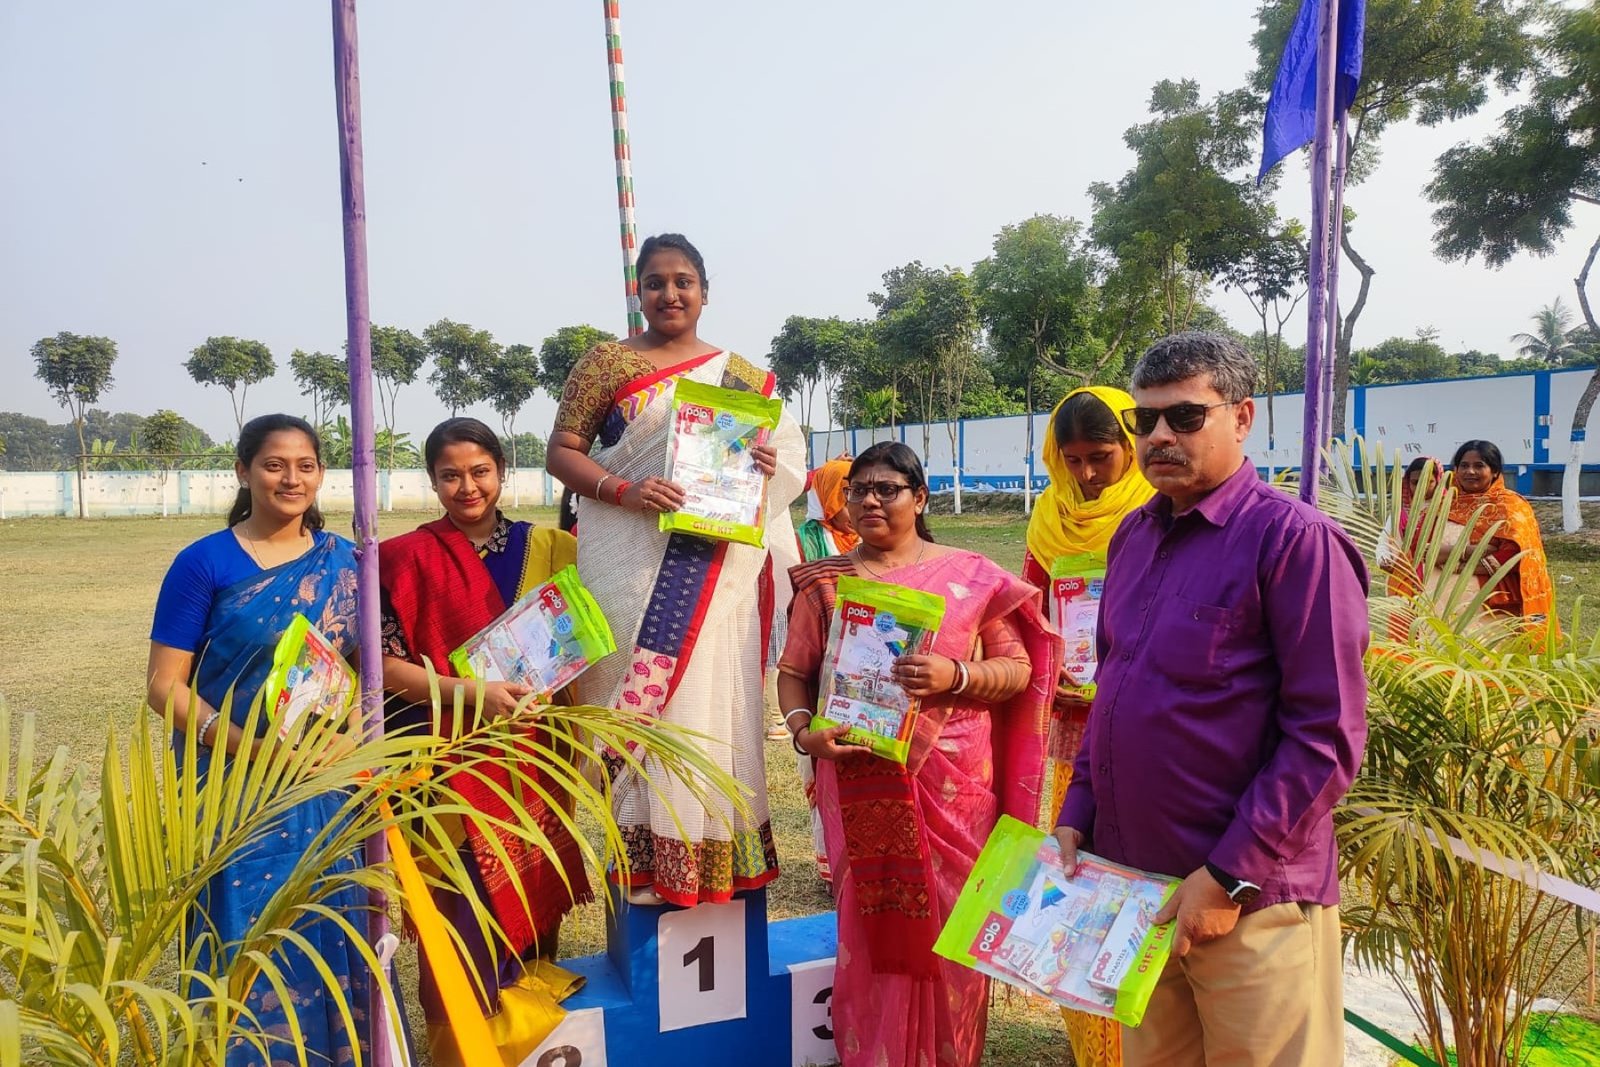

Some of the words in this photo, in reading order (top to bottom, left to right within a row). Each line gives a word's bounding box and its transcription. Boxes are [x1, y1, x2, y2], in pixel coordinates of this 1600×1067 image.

[687, 407, 708, 419] polo
[543, 588, 562, 609] polo
[1058, 580, 1080, 596] polo
[847, 606, 869, 619] polo
[830, 699, 851, 712] polo
[979, 922, 1001, 952] polo
[1138, 943, 1158, 973] GIFT
[1154, 926, 1168, 940] KI
[683, 935, 715, 992] 1
[1092, 951, 1113, 982] polo
